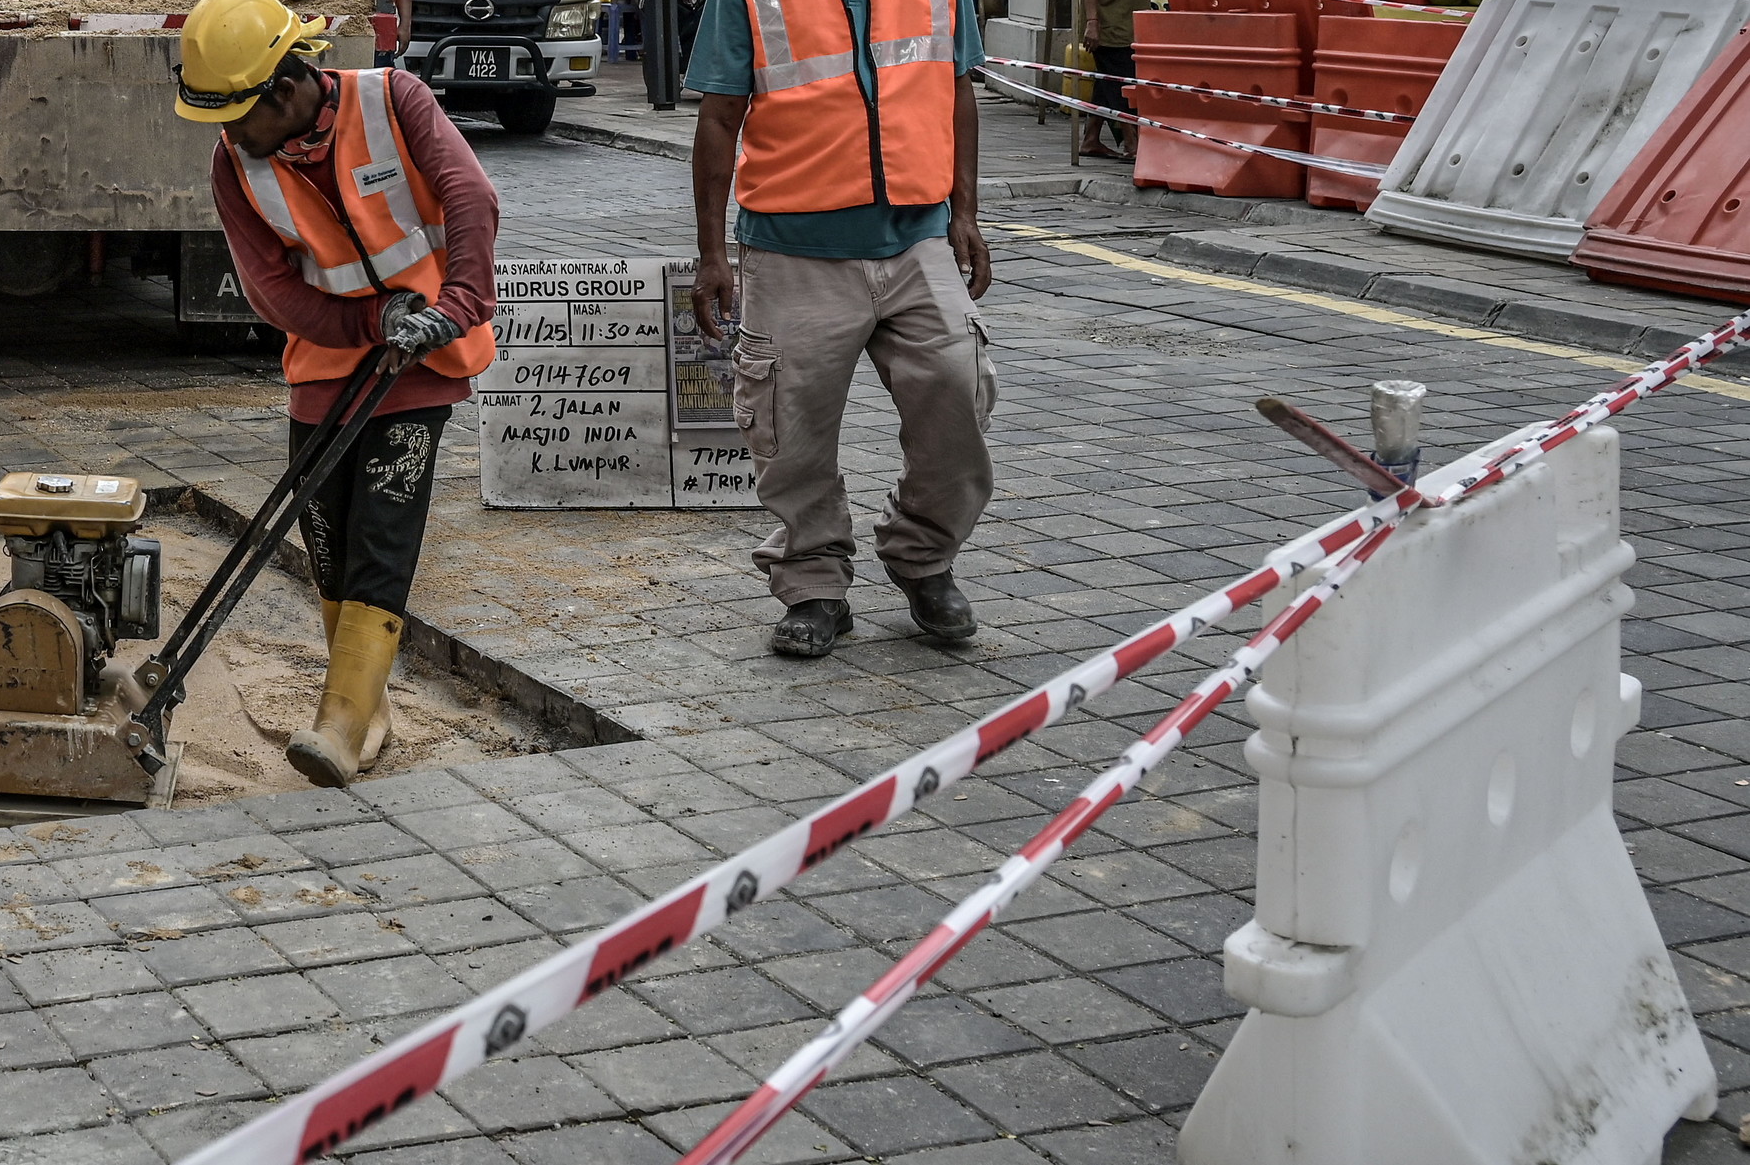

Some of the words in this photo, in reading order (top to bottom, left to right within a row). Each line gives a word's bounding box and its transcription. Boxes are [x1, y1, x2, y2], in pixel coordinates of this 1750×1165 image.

[470, 50, 495, 64] VKA
[468, 64, 497, 78] 4122
[510, 262, 558, 276] SYARIKAT
[560, 261, 628, 275] KONTRAKOR
[575, 279, 646, 297] GROUP
[581, 322, 630, 341] 11:30
[635, 324, 660, 337] AM
[514, 364, 631, 388] 09147609
[677, 379, 721, 395] TAMATKAN
[481, 394, 522, 407] ALAMAT
[552, 397, 621, 420] JALAN
[501, 425, 570, 447] MASJID
[584, 426, 637, 444] INDIA
